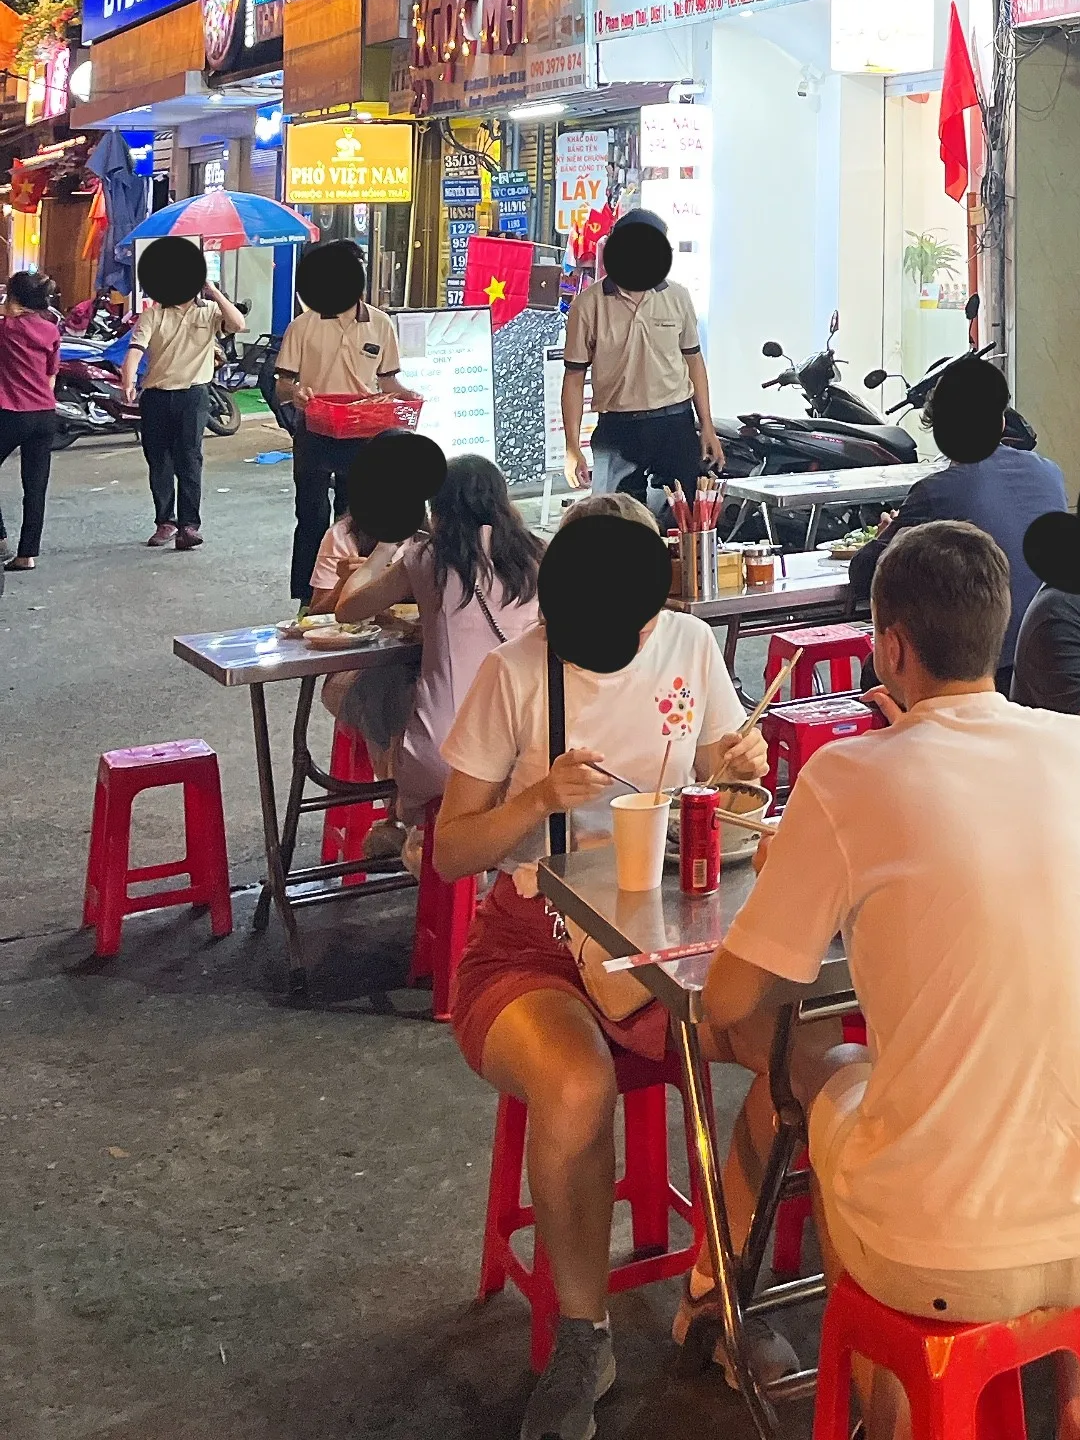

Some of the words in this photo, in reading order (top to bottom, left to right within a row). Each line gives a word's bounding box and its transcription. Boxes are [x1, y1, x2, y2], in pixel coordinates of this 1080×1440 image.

[593, 9, 604, 36] 18
[445, 154, 476, 167] 35/13
[290, 160, 326, 186] PHỞ
[328, 162, 369, 190] VIỆT
[370, 166, 409, 185] NAM
[562, 173, 602, 201] LẤY
[451, 223, 476, 235] 12/2
[447, 290, 465, 305] 572
[454, 365, 483, 375] 80.000
[452, 384, 484, 394] 120.000
